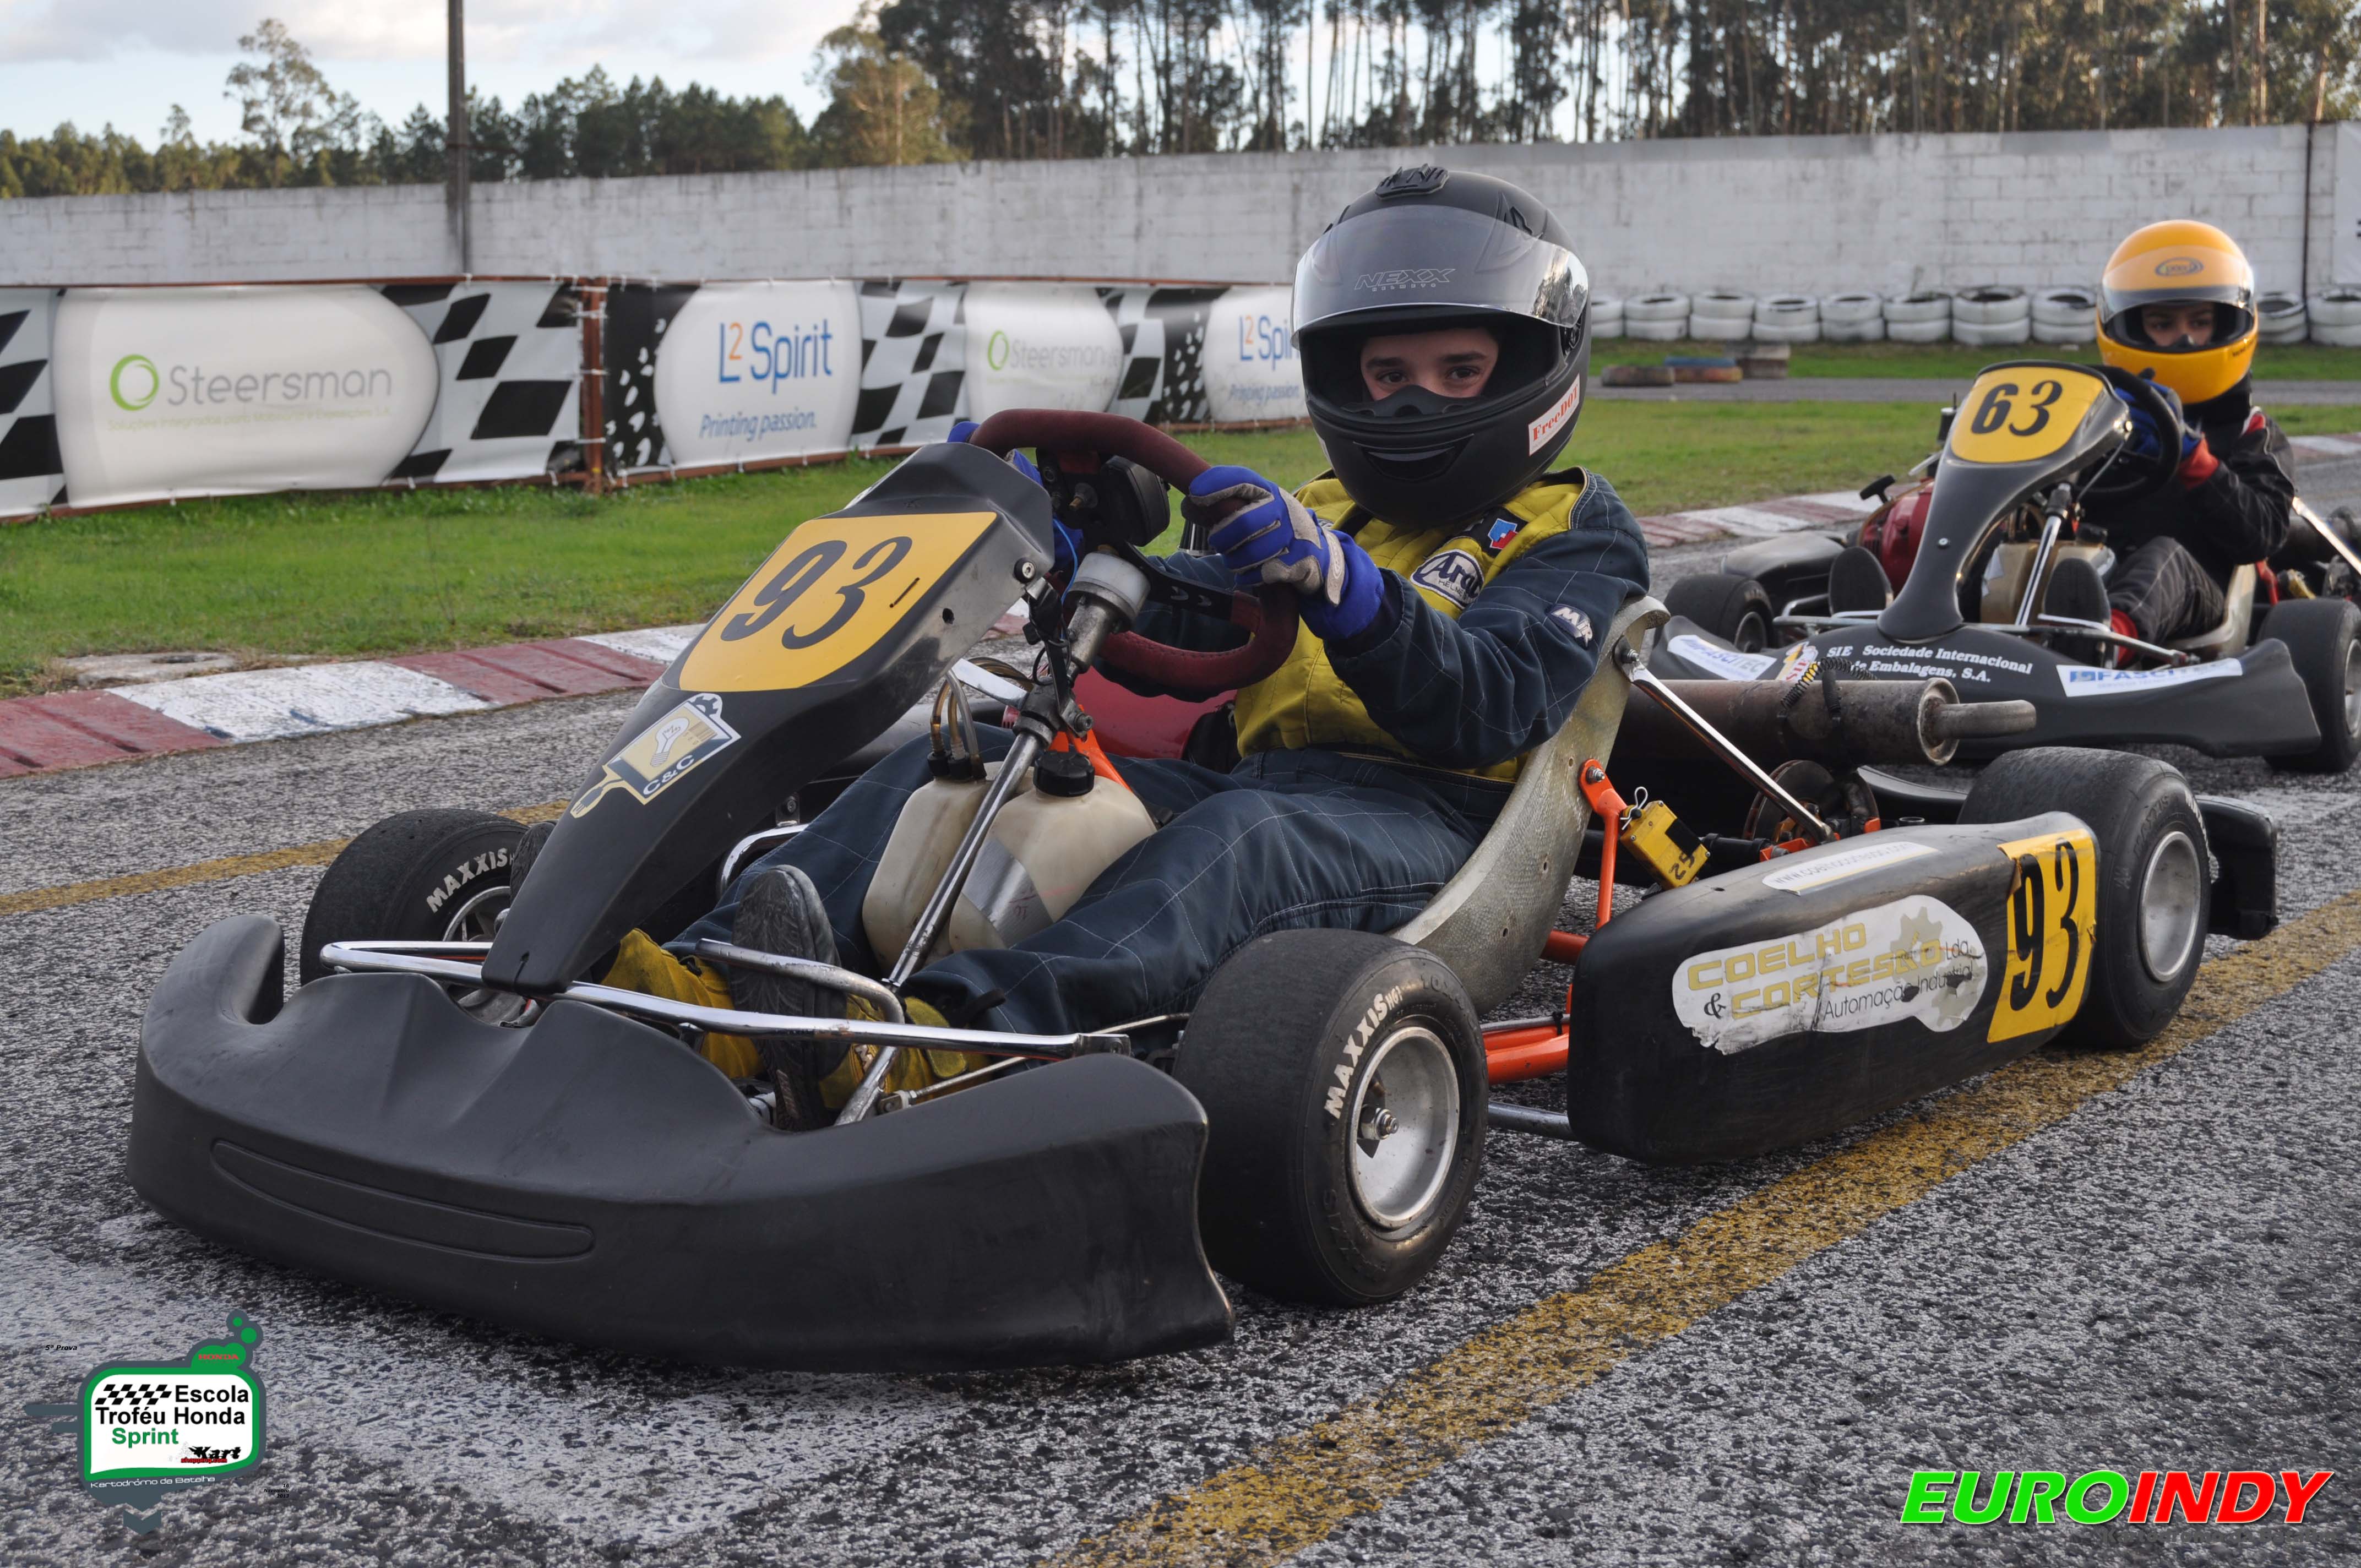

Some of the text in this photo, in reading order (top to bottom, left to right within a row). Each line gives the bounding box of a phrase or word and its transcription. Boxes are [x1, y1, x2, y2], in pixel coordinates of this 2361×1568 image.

[1354, 269, 1456, 290] NEXX
[750, 319, 832, 394] Spirit
[1010, 338, 1103, 369] Steersman
[167, 366, 391, 406] Steersman
[699, 407, 817, 441] Printing passion.
[1971, 380, 2063, 437] 63
[721, 536, 912, 650] 93
[1827, 645, 2033, 674] SIE Sociedade Internacional
[1869, 660, 1957, 679] Embalagens,
[1961, 668, 1992, 683] S.A.
[643, 755, 694, 795] C&C
[427, 848, 510, 913] MAXXIS
[2009, 837, 2079, 1012] 93
[1687, 922, 1867, 991] COELHO
[1704, 993, 1727, 1019] &
[1324, 993, 1388, 1120] MAXXIS
